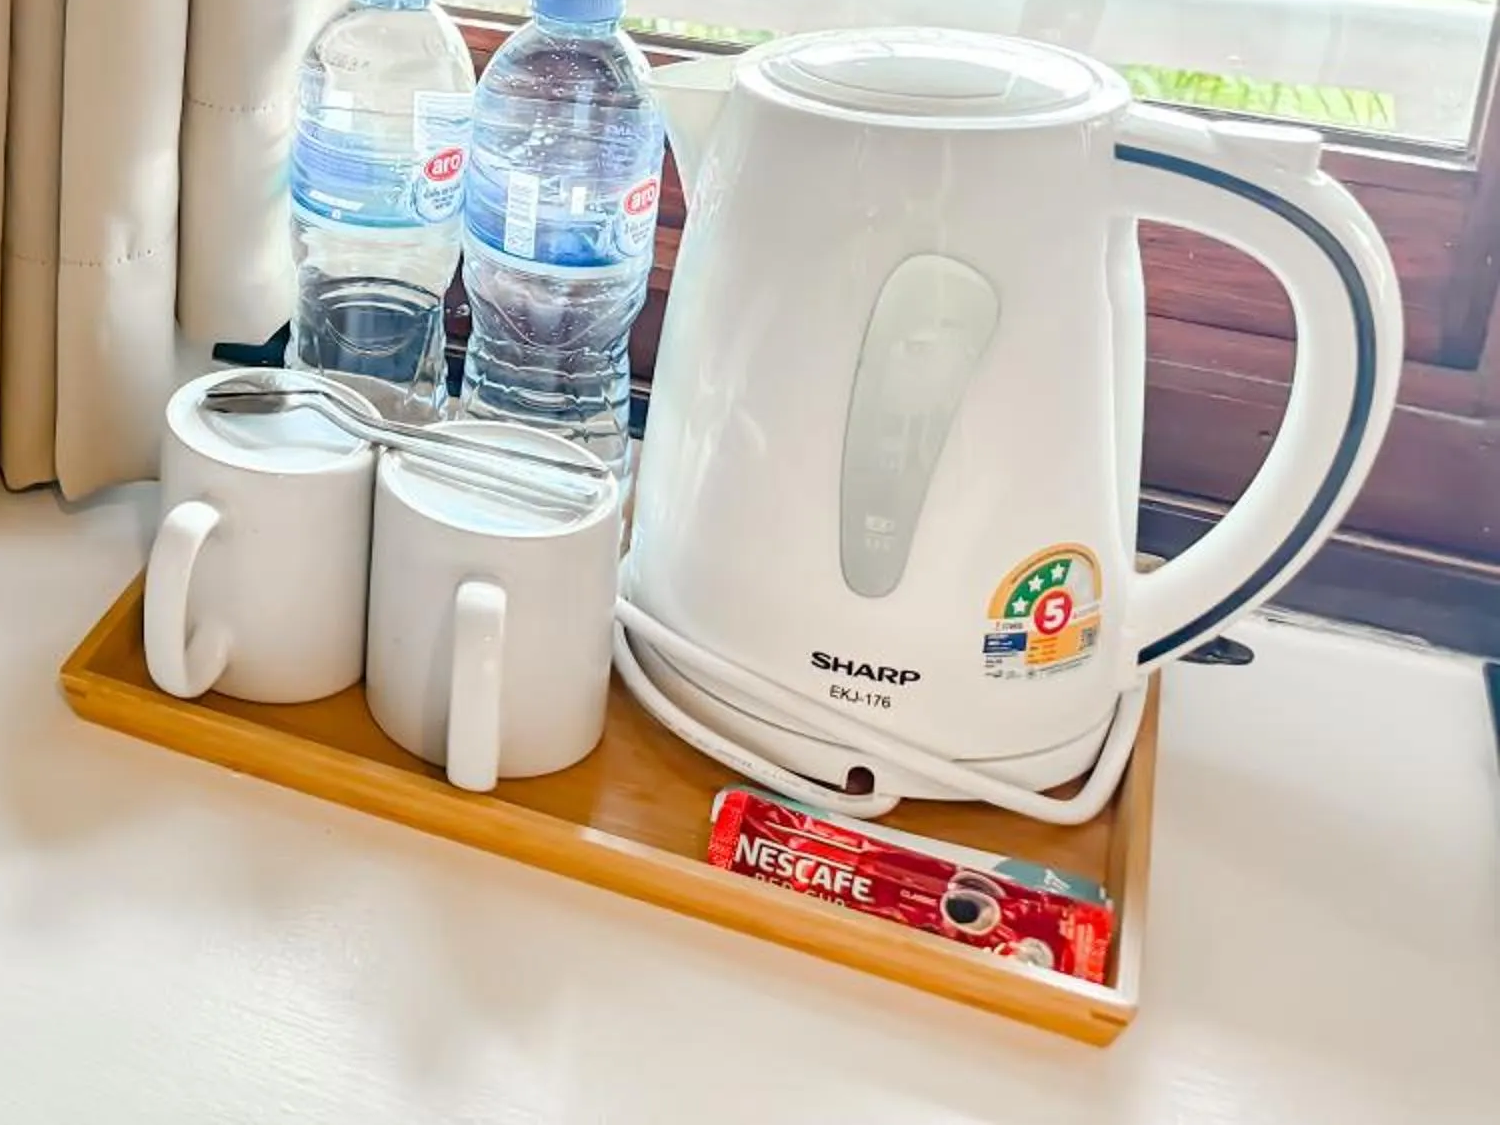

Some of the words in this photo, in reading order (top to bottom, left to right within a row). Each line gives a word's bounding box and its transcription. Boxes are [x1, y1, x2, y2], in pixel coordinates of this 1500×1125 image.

[432, 154, 461, 176] aro
[631, 184, 656, 209] aro
[1043, 597, 1066, 628] 5
[810, 650, 921, 686] SHARP
[829, 684, 891, 709] EKJ-176
